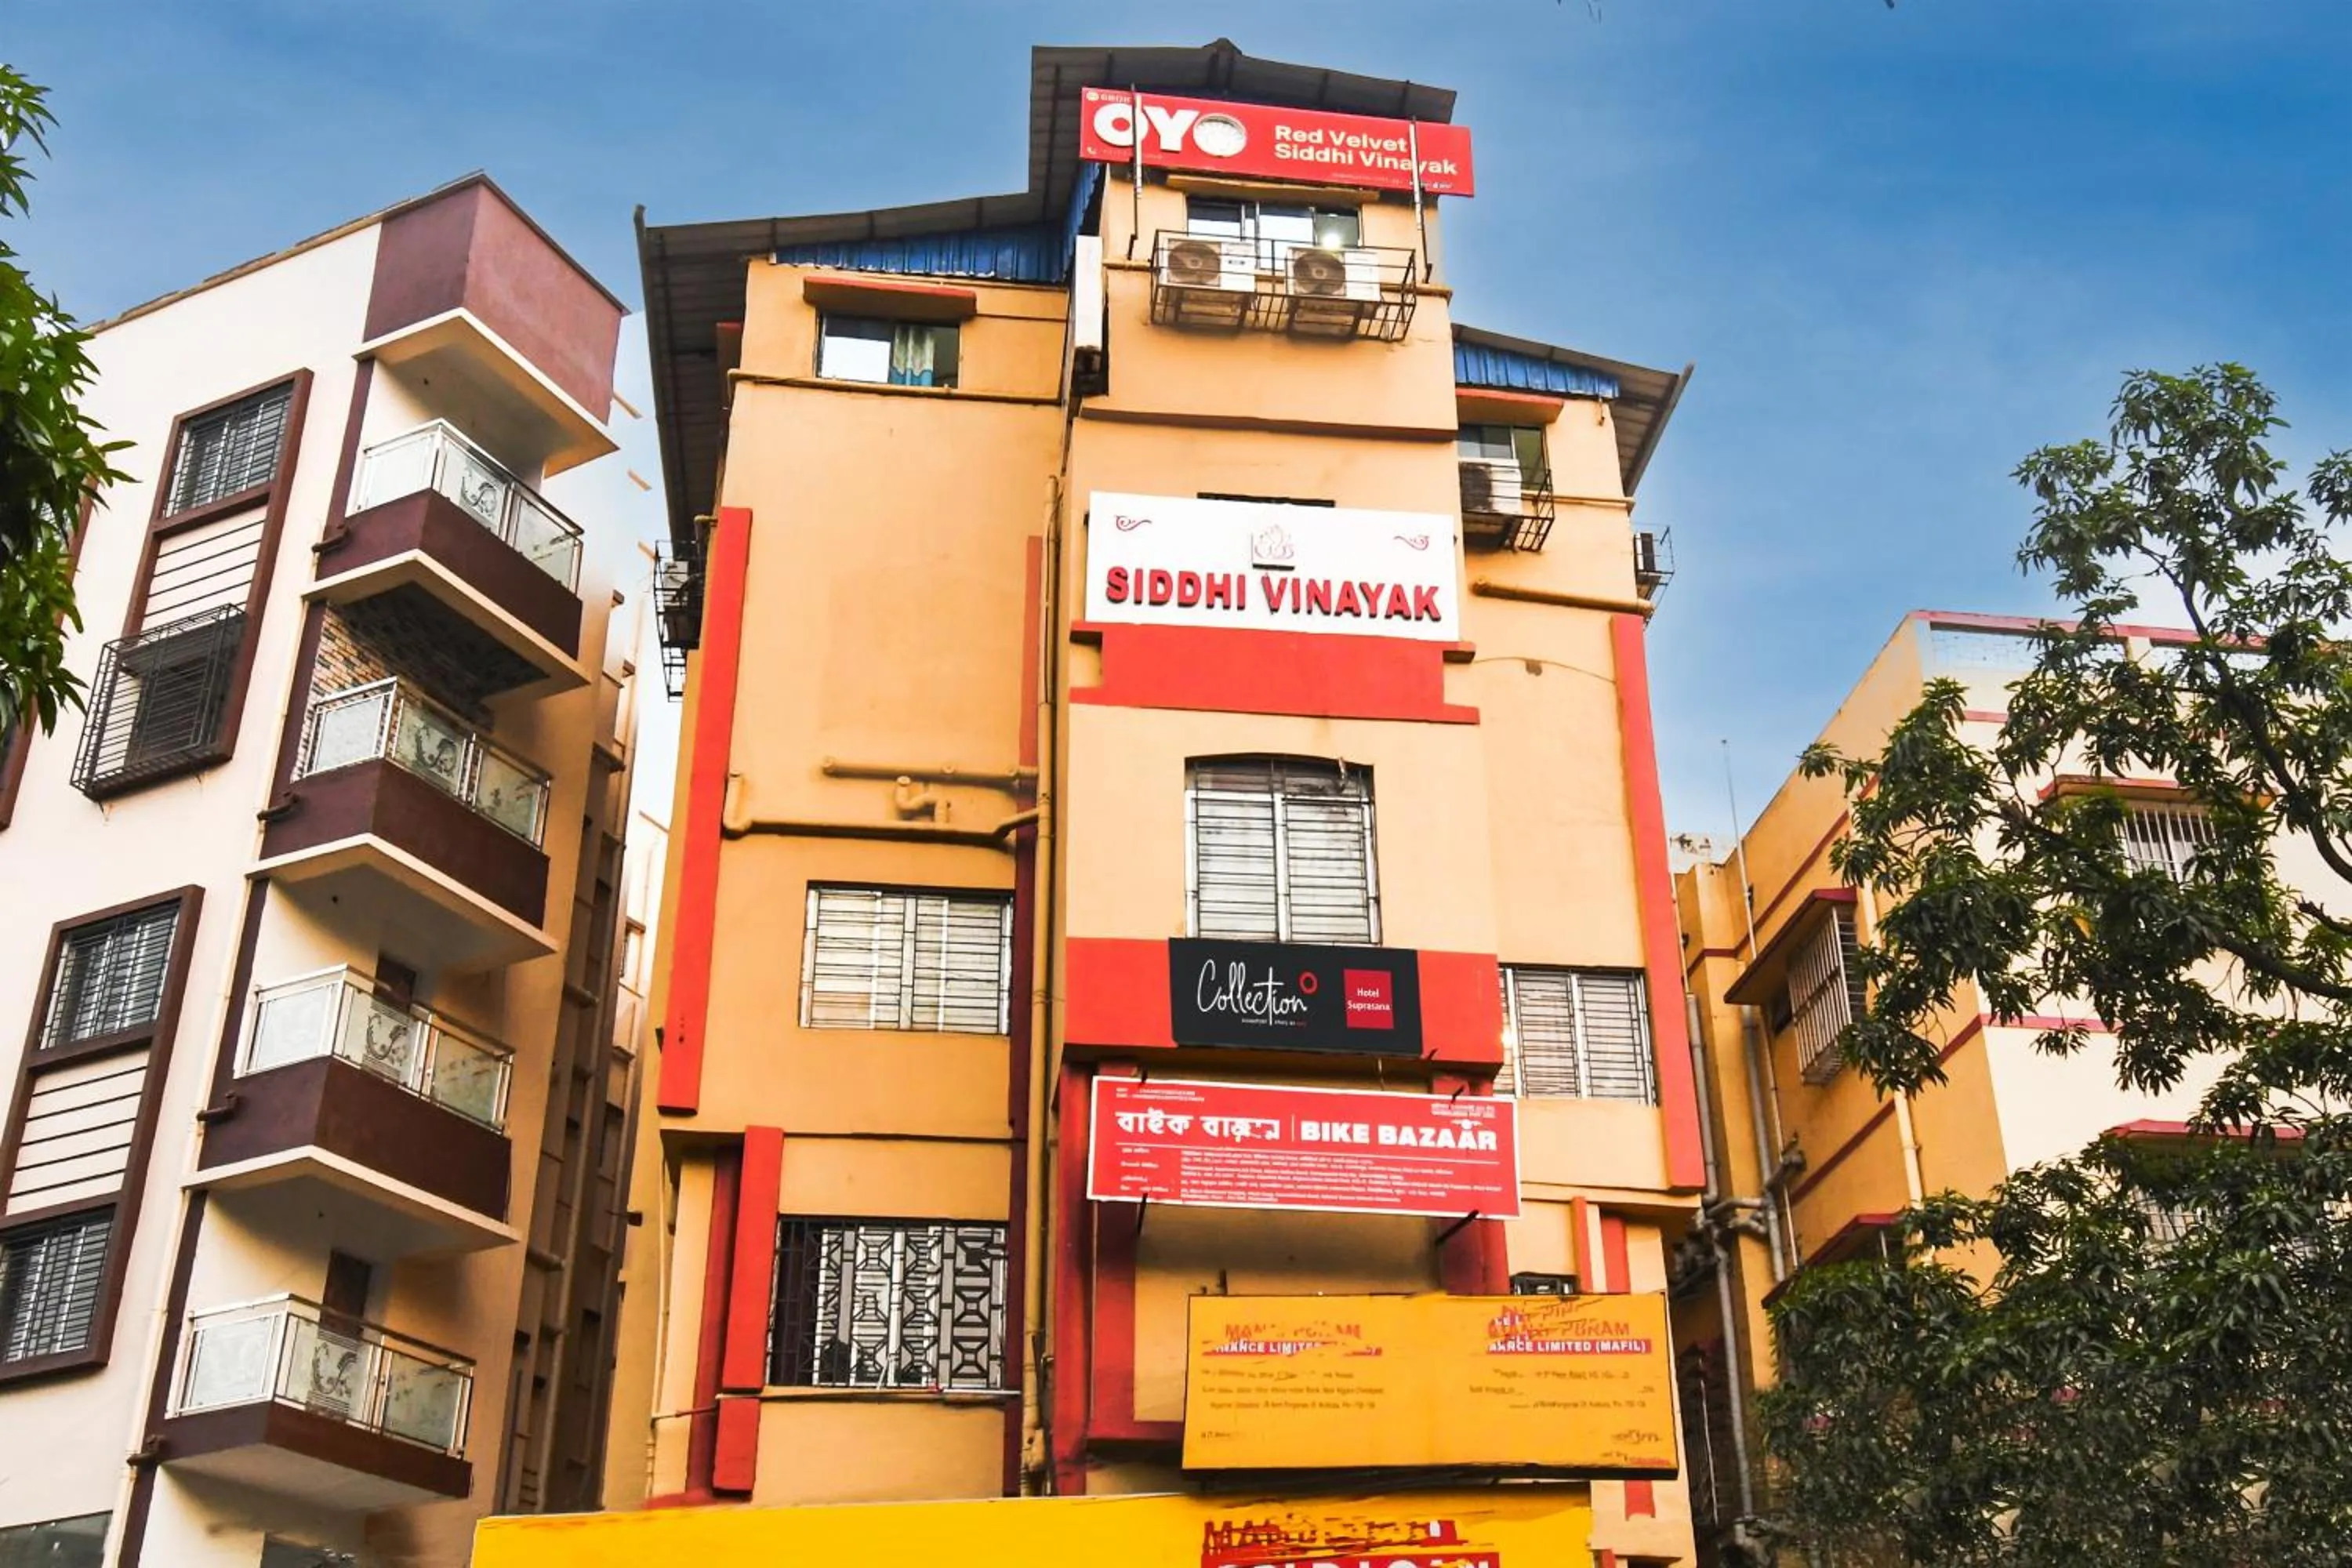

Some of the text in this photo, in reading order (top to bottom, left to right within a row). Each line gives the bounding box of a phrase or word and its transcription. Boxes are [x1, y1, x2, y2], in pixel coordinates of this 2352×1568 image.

[1093, 102, 1247, 157] OYO
[1275, 125, 1408, 153] Red Velvet
[1275, 143, 1354, 165] Siddhi
[1105, 565, 1442, 622] SIDDHI VINAYAK
[1197, 959, 1308, 1026] Collection
[1357, 987, 1380, 998] Hotel
[1115, 1107, 1194, 1135] বাইক
[1301, 1121, 1497, 1151] BIKE BAZAAR
[1537, 1341, 1592, 1352] LIMITED
[1595, 1340, 1646, 1353] (MAFIL)
